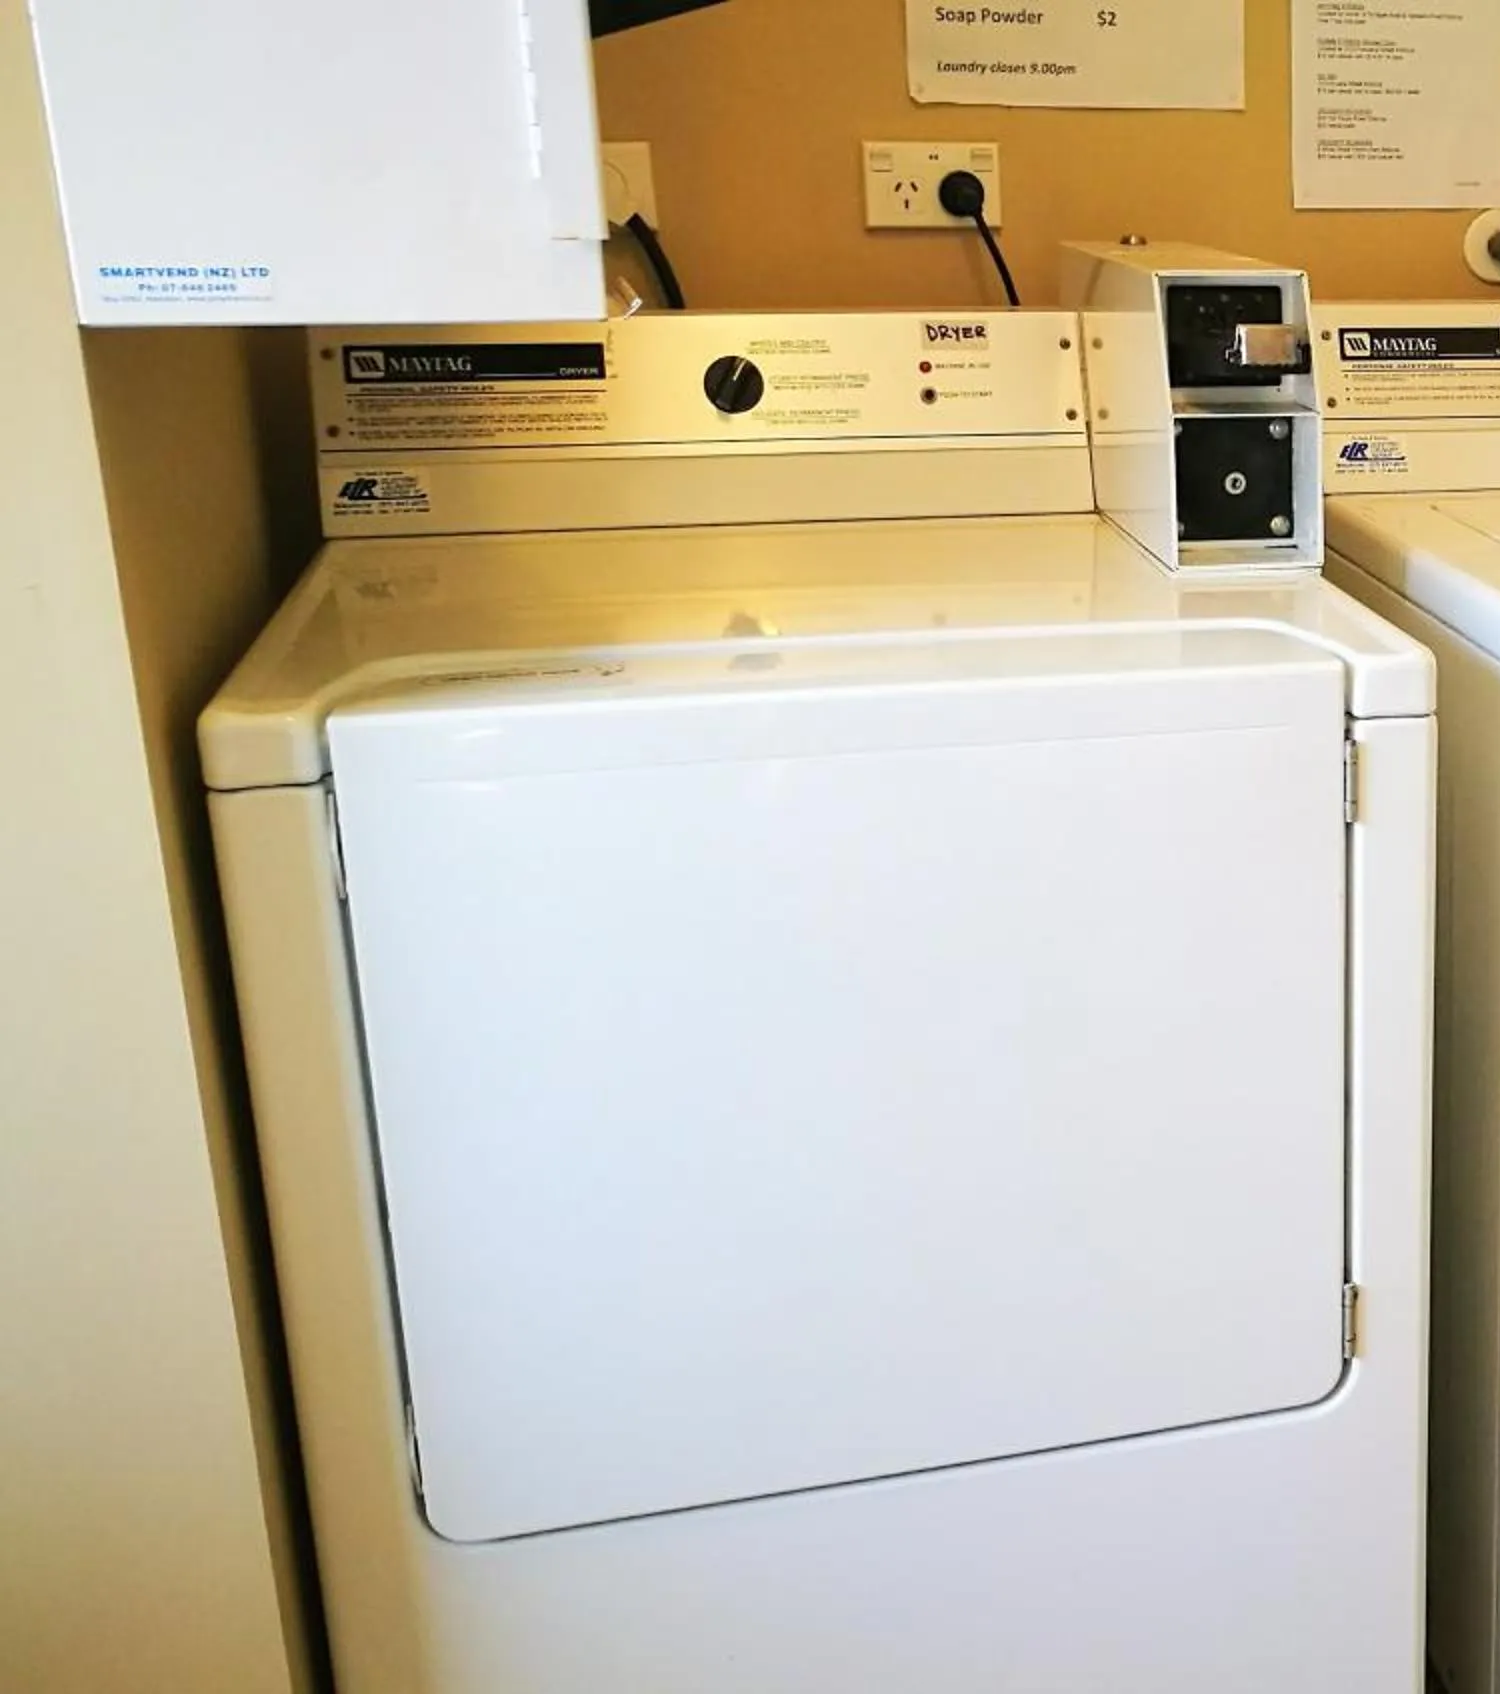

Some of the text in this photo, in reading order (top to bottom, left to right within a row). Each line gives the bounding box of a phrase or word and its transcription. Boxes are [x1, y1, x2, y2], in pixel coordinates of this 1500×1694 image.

[935, 6, 1117, 27] Soap Powder $2
[937, 61, 1076, 77] Laundry closes 9.00pm
[99, 266, 270, 279] SMARTVEND (NZ) LTD
[927, 324, 986, 341] DRYER
[1373, 337, 1437, 350] MAYTAG
[388, 356, 472, 373] MAYTAG
[558, 367, 599, 375] DRYER
